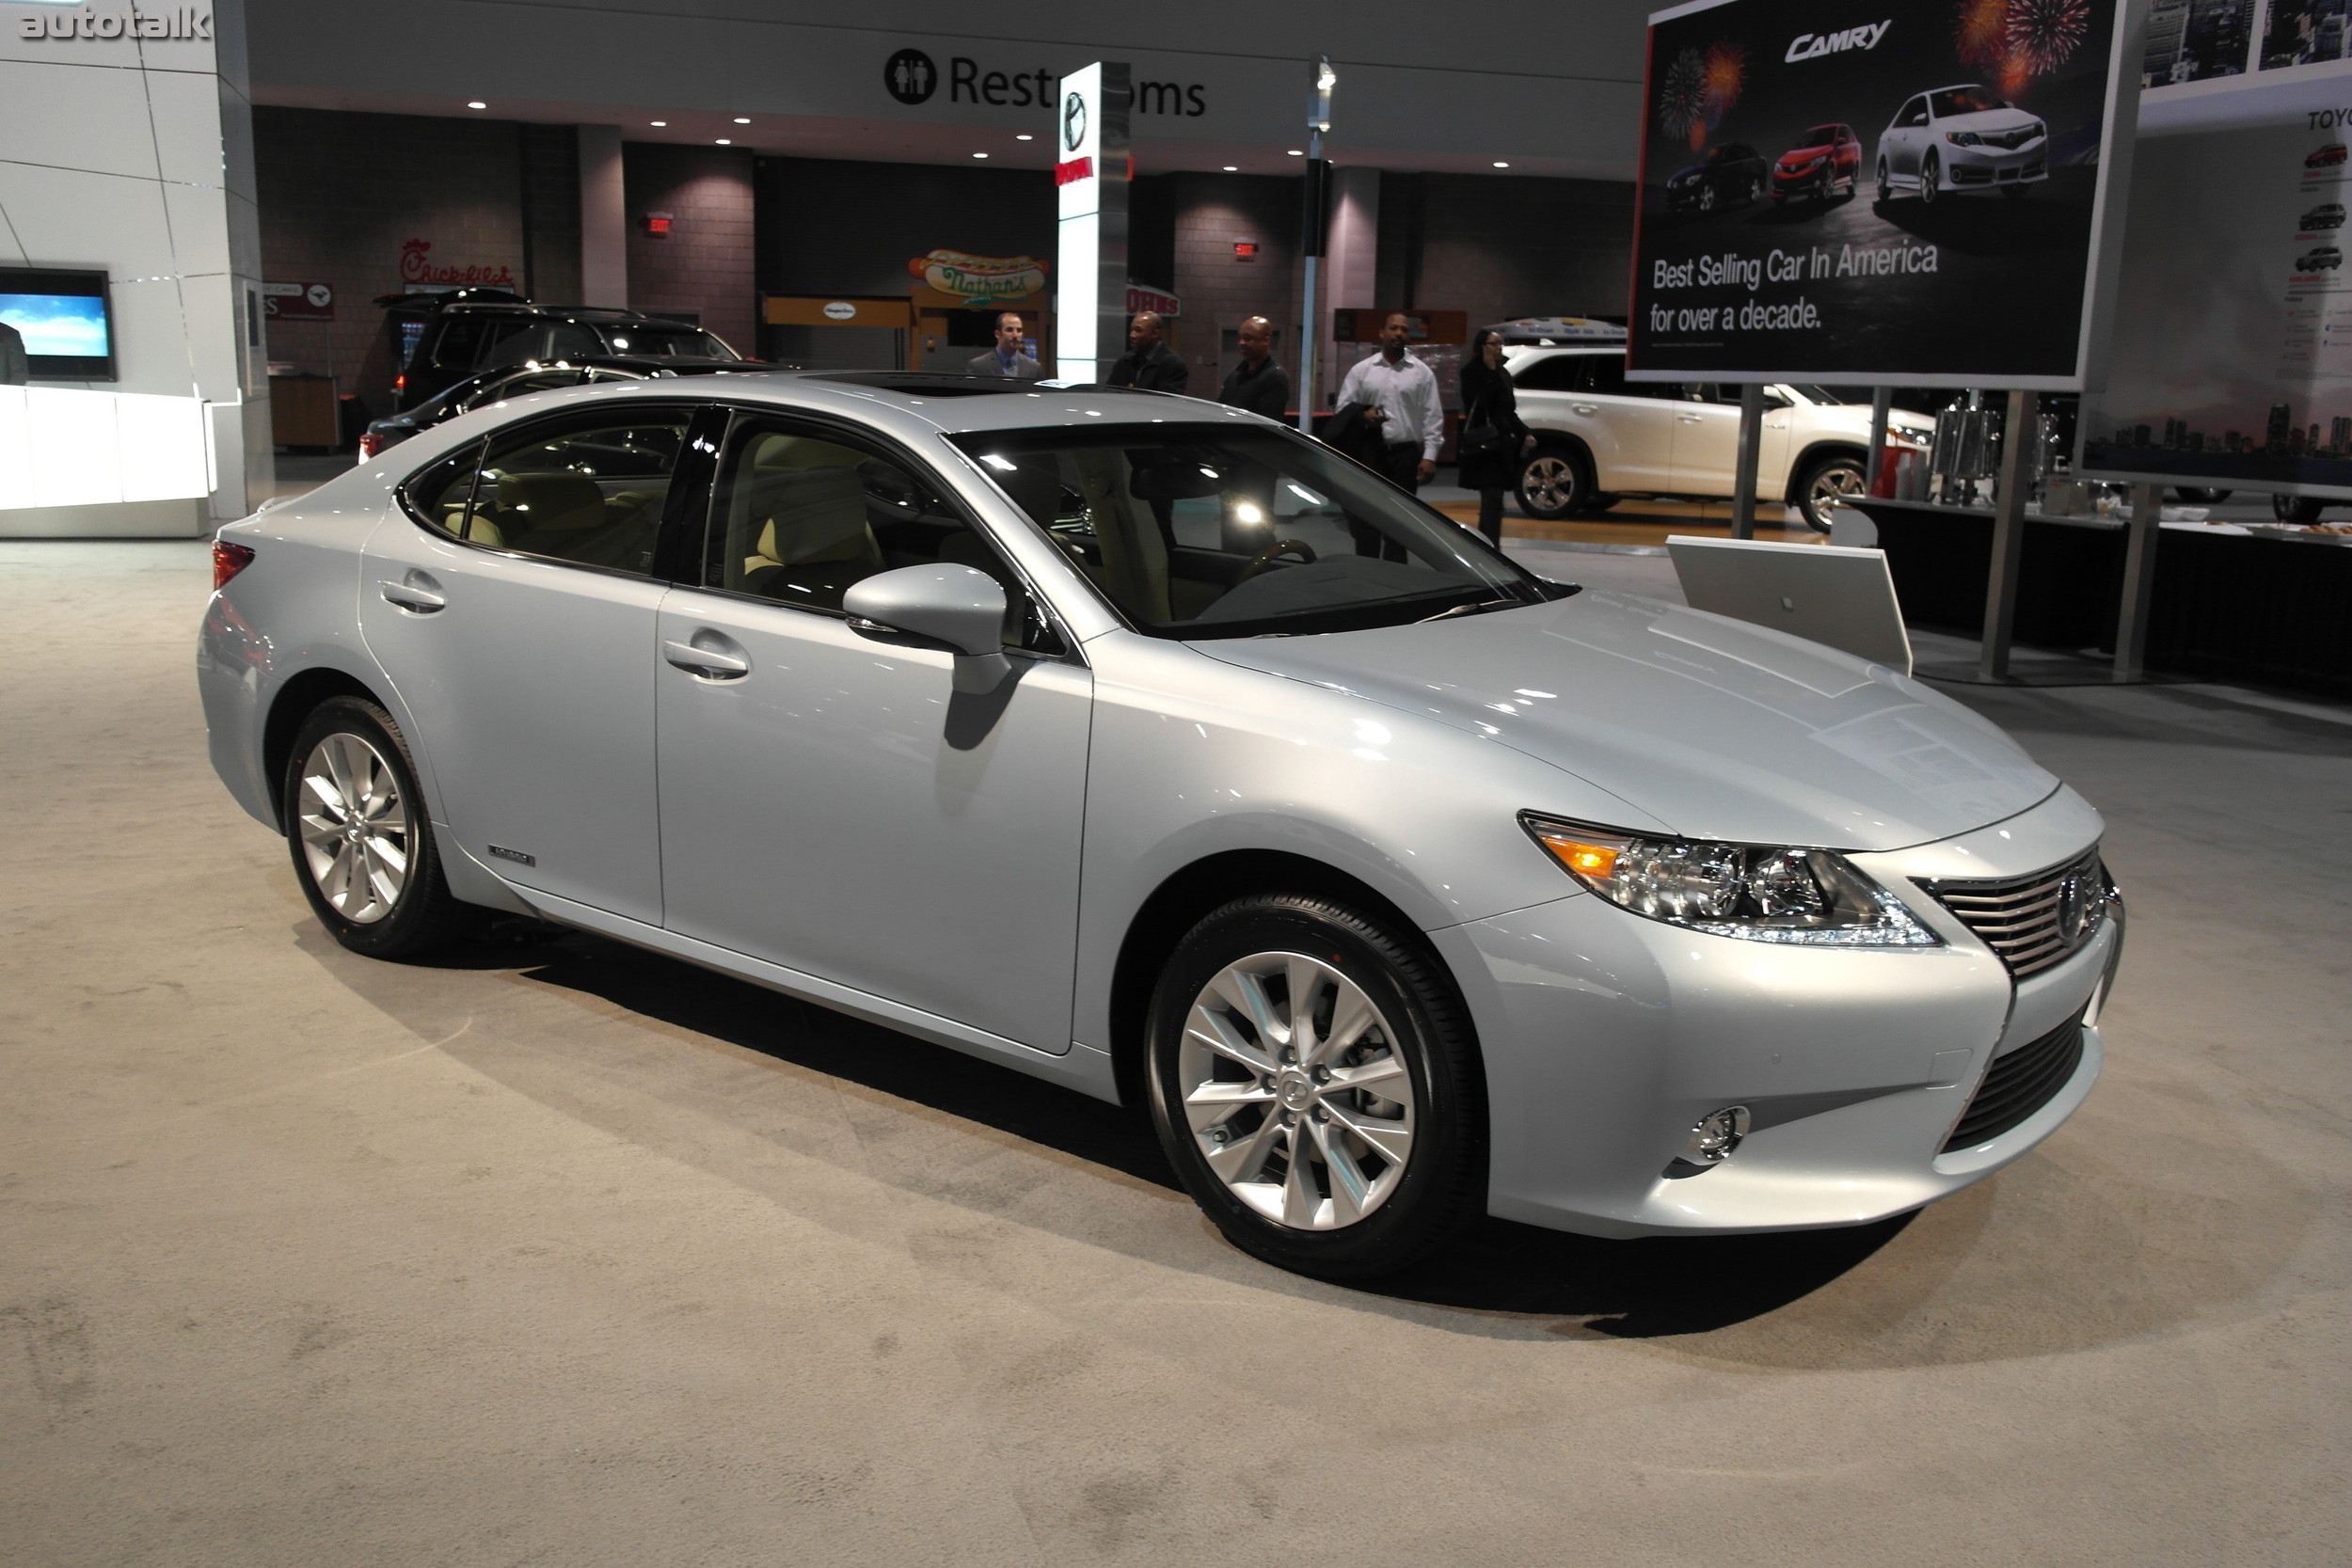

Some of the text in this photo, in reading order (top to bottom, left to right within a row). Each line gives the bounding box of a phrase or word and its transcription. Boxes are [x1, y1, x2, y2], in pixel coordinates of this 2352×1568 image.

[1785, 19, 1892, 63] CAMRY
[1653, 238, 1938, 291] Best Selling Car In America
[1650, 296, 1821, 331] for over a decade.
